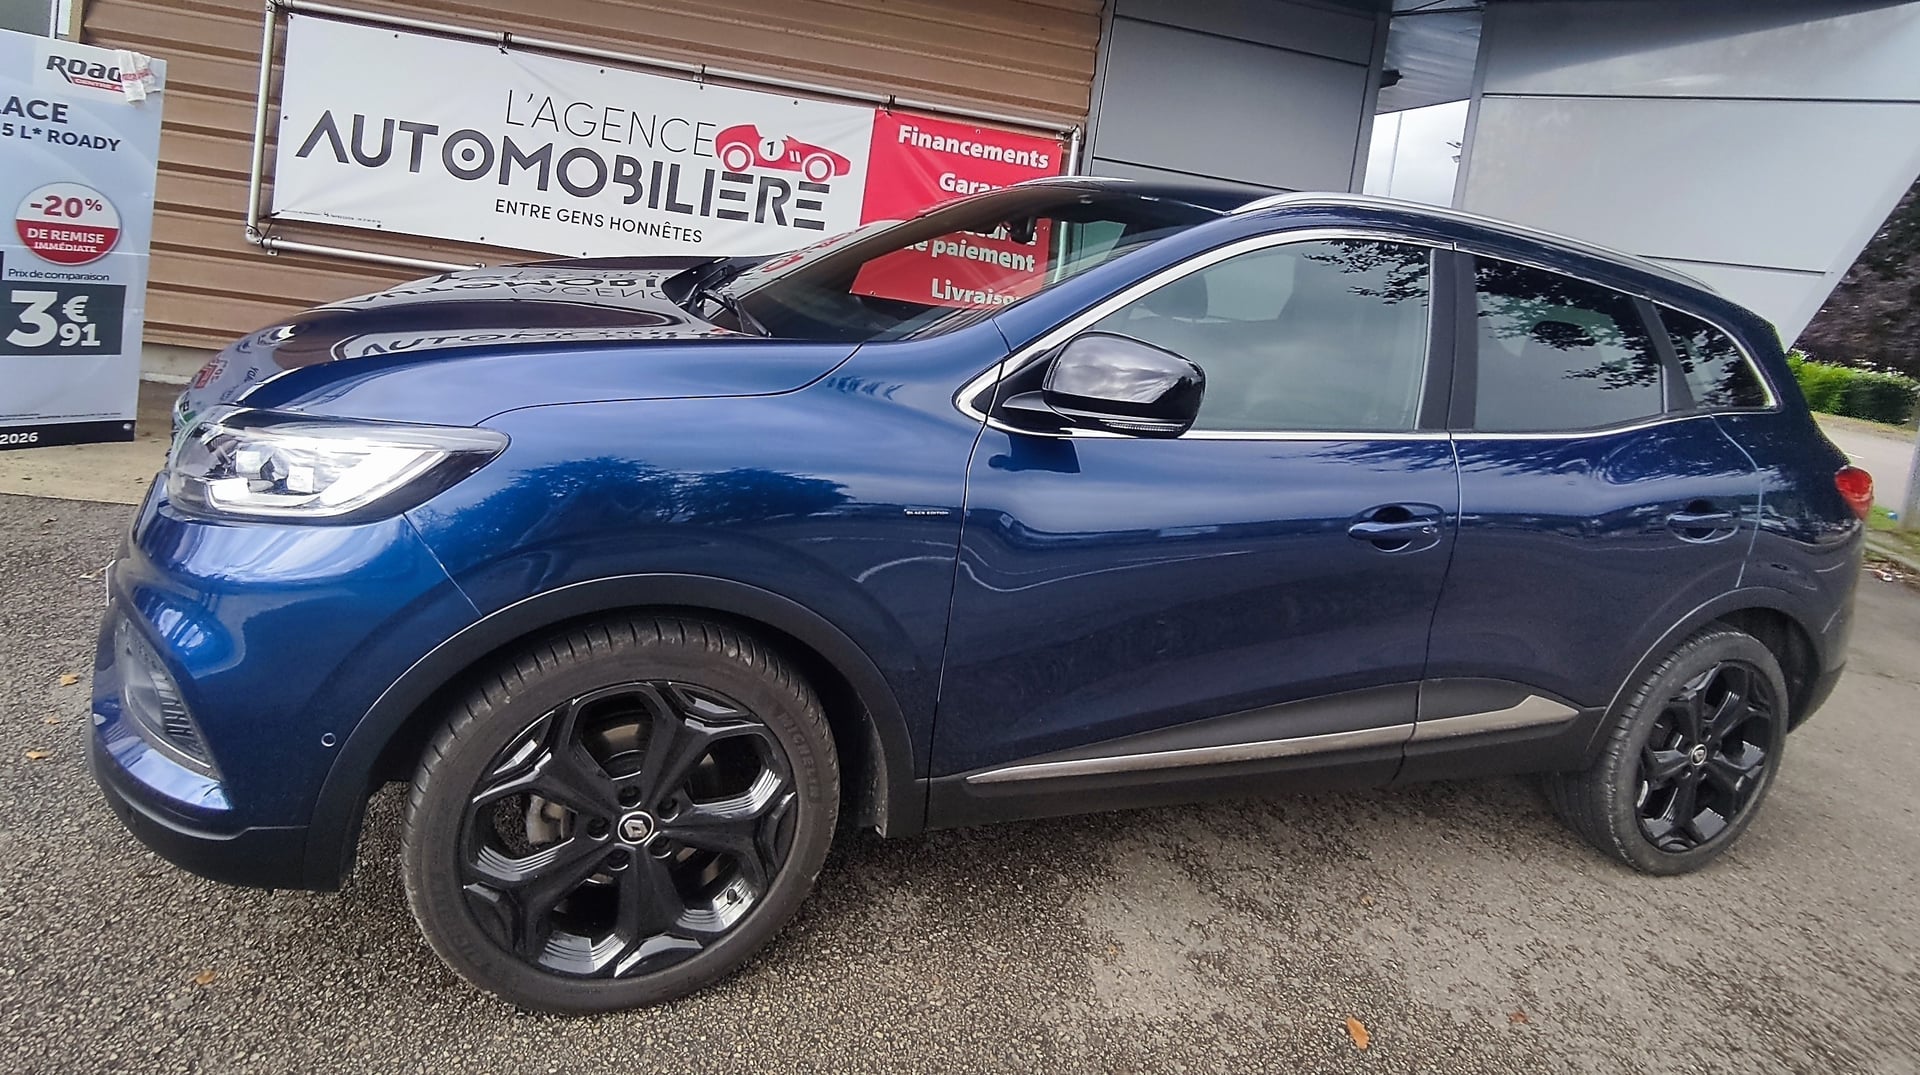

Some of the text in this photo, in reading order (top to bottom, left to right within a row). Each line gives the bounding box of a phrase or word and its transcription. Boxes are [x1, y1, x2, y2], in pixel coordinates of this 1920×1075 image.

[0, 96, 68, 123] ACE
[506, 89, 717, 157] L'AGENCE
[47, 129, 121, 151] ROADY
[766, 140, 776, 156] 1
[898, 125, 1049, 169] Financements
[30, 195, 102, 218] -20%
[495, 199, 703, 243] ENTRE GENS HONNÊTES
[27, 228, 105, 244] DE REMISE
[33, 241, 97, 253] IMMÉDIATE
[931, 239, 1035, 273] paiement
[8, 269, 110, 281] Prix de comparaison
[0, 432, 39, 444] 2026
